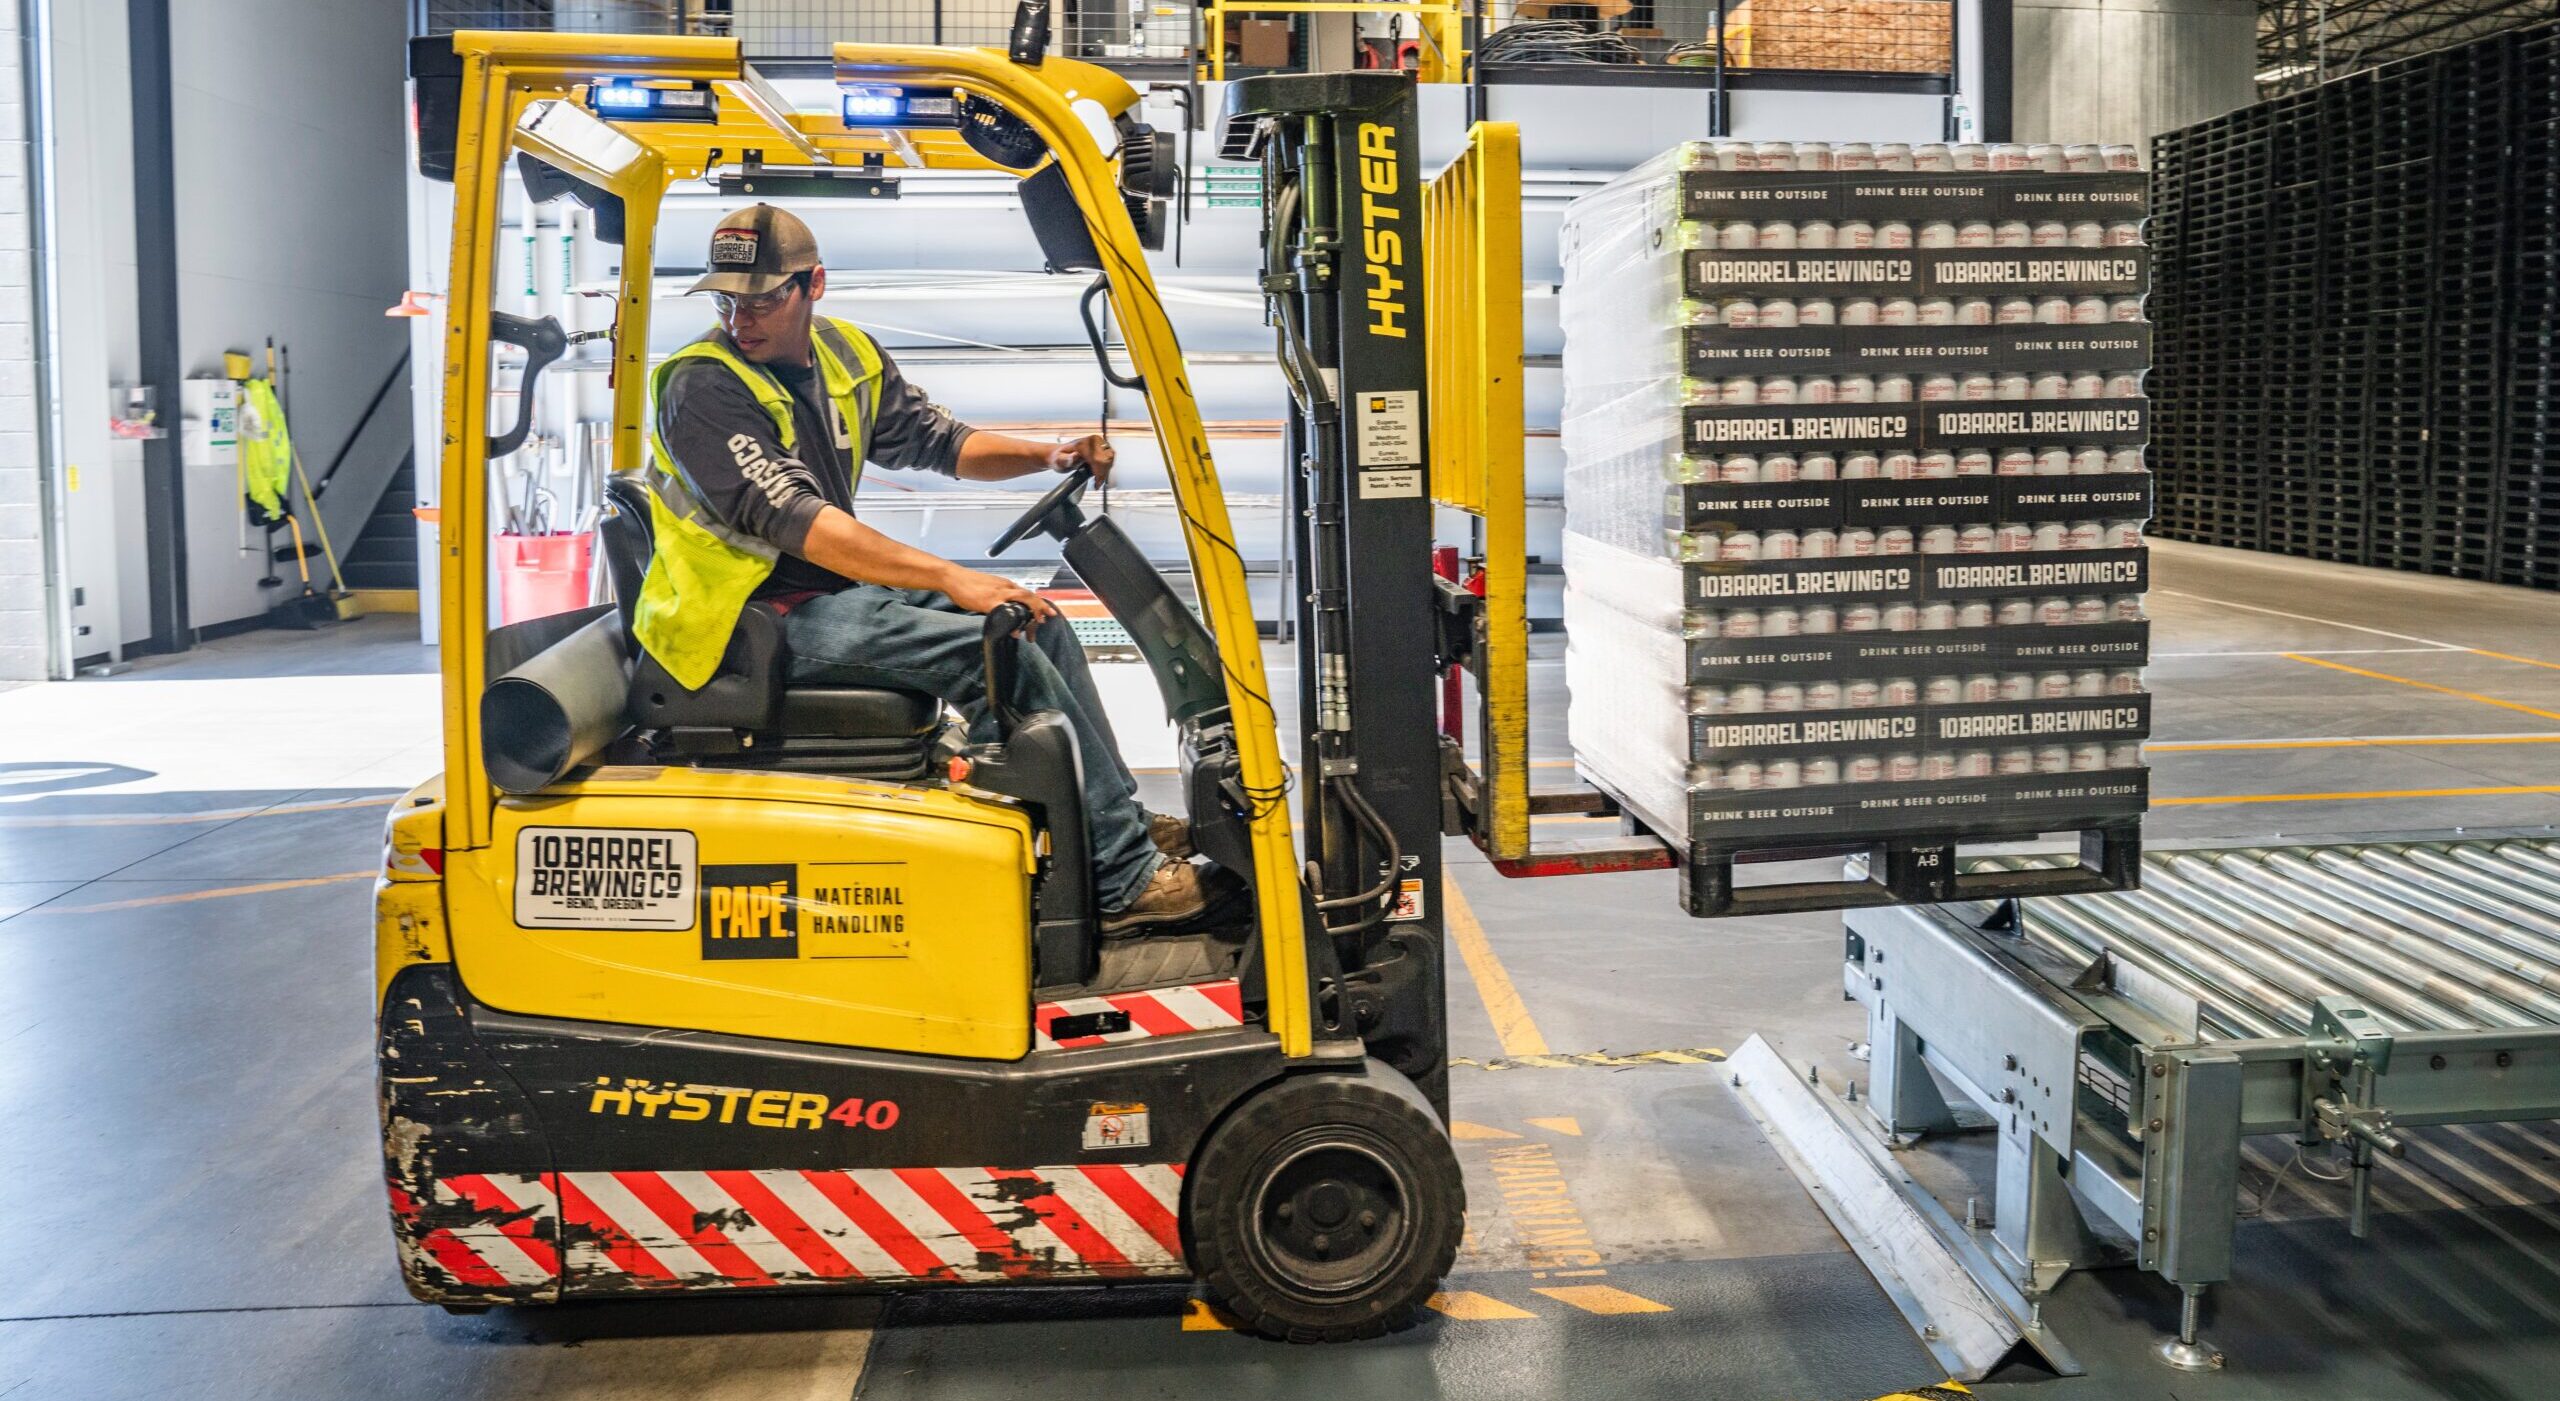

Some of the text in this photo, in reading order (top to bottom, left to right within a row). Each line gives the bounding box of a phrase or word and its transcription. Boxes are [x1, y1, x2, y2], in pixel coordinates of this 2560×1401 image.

[1694, 190, 1828, 200] DRINK BEER OUTSIDE
[1855, 187, 1985, 197] DRINK BEER OUTSIDE
[2014, 192, 2140, 202] DRINK BEER OUTSIDE
[1358, 122, 1407, 338] HYSTER
[1860, 346, 1989, 357] DRINK BEER OUTSIDE
[2015, 339, 2139, 351] DRINK BEER OUTSIDE
[1698, 347, 1831, 359] DRINK BEER OUTSIDE
[1697, 497, 1830, 511] DRINK BEER OUTSIDE
[1861, 495, 1989, 508] DRINK BEER OUTSIDE
[2017, 492, 2141, 504] DRINK BEER OUTSIDE
[1859, 643, 1987, 657] DRINK BEER OUTSIDE
[2016, 642, 2139, 656] DRINK BEER OUTSIDE
[1701, 651, 1833, 666] DRINK BEER OUTSIDE
[2014, 784, 2137, 800] DRINK BEER OUTSIDE
[1860, 793, 1987, 809] DRINK BEER OUTSIDE
[1703, 806, 1834, 821] DRINK BEER OUTSIDE
[1917, 854, 1940, 868] A-B
[814, 887, 904, 906] MATERIAL
[602, 898, 645, 911] OREGON
[813, 914, 905, 934] HANDLING
[589, 1076, 901, 1131] HYSTER 40
